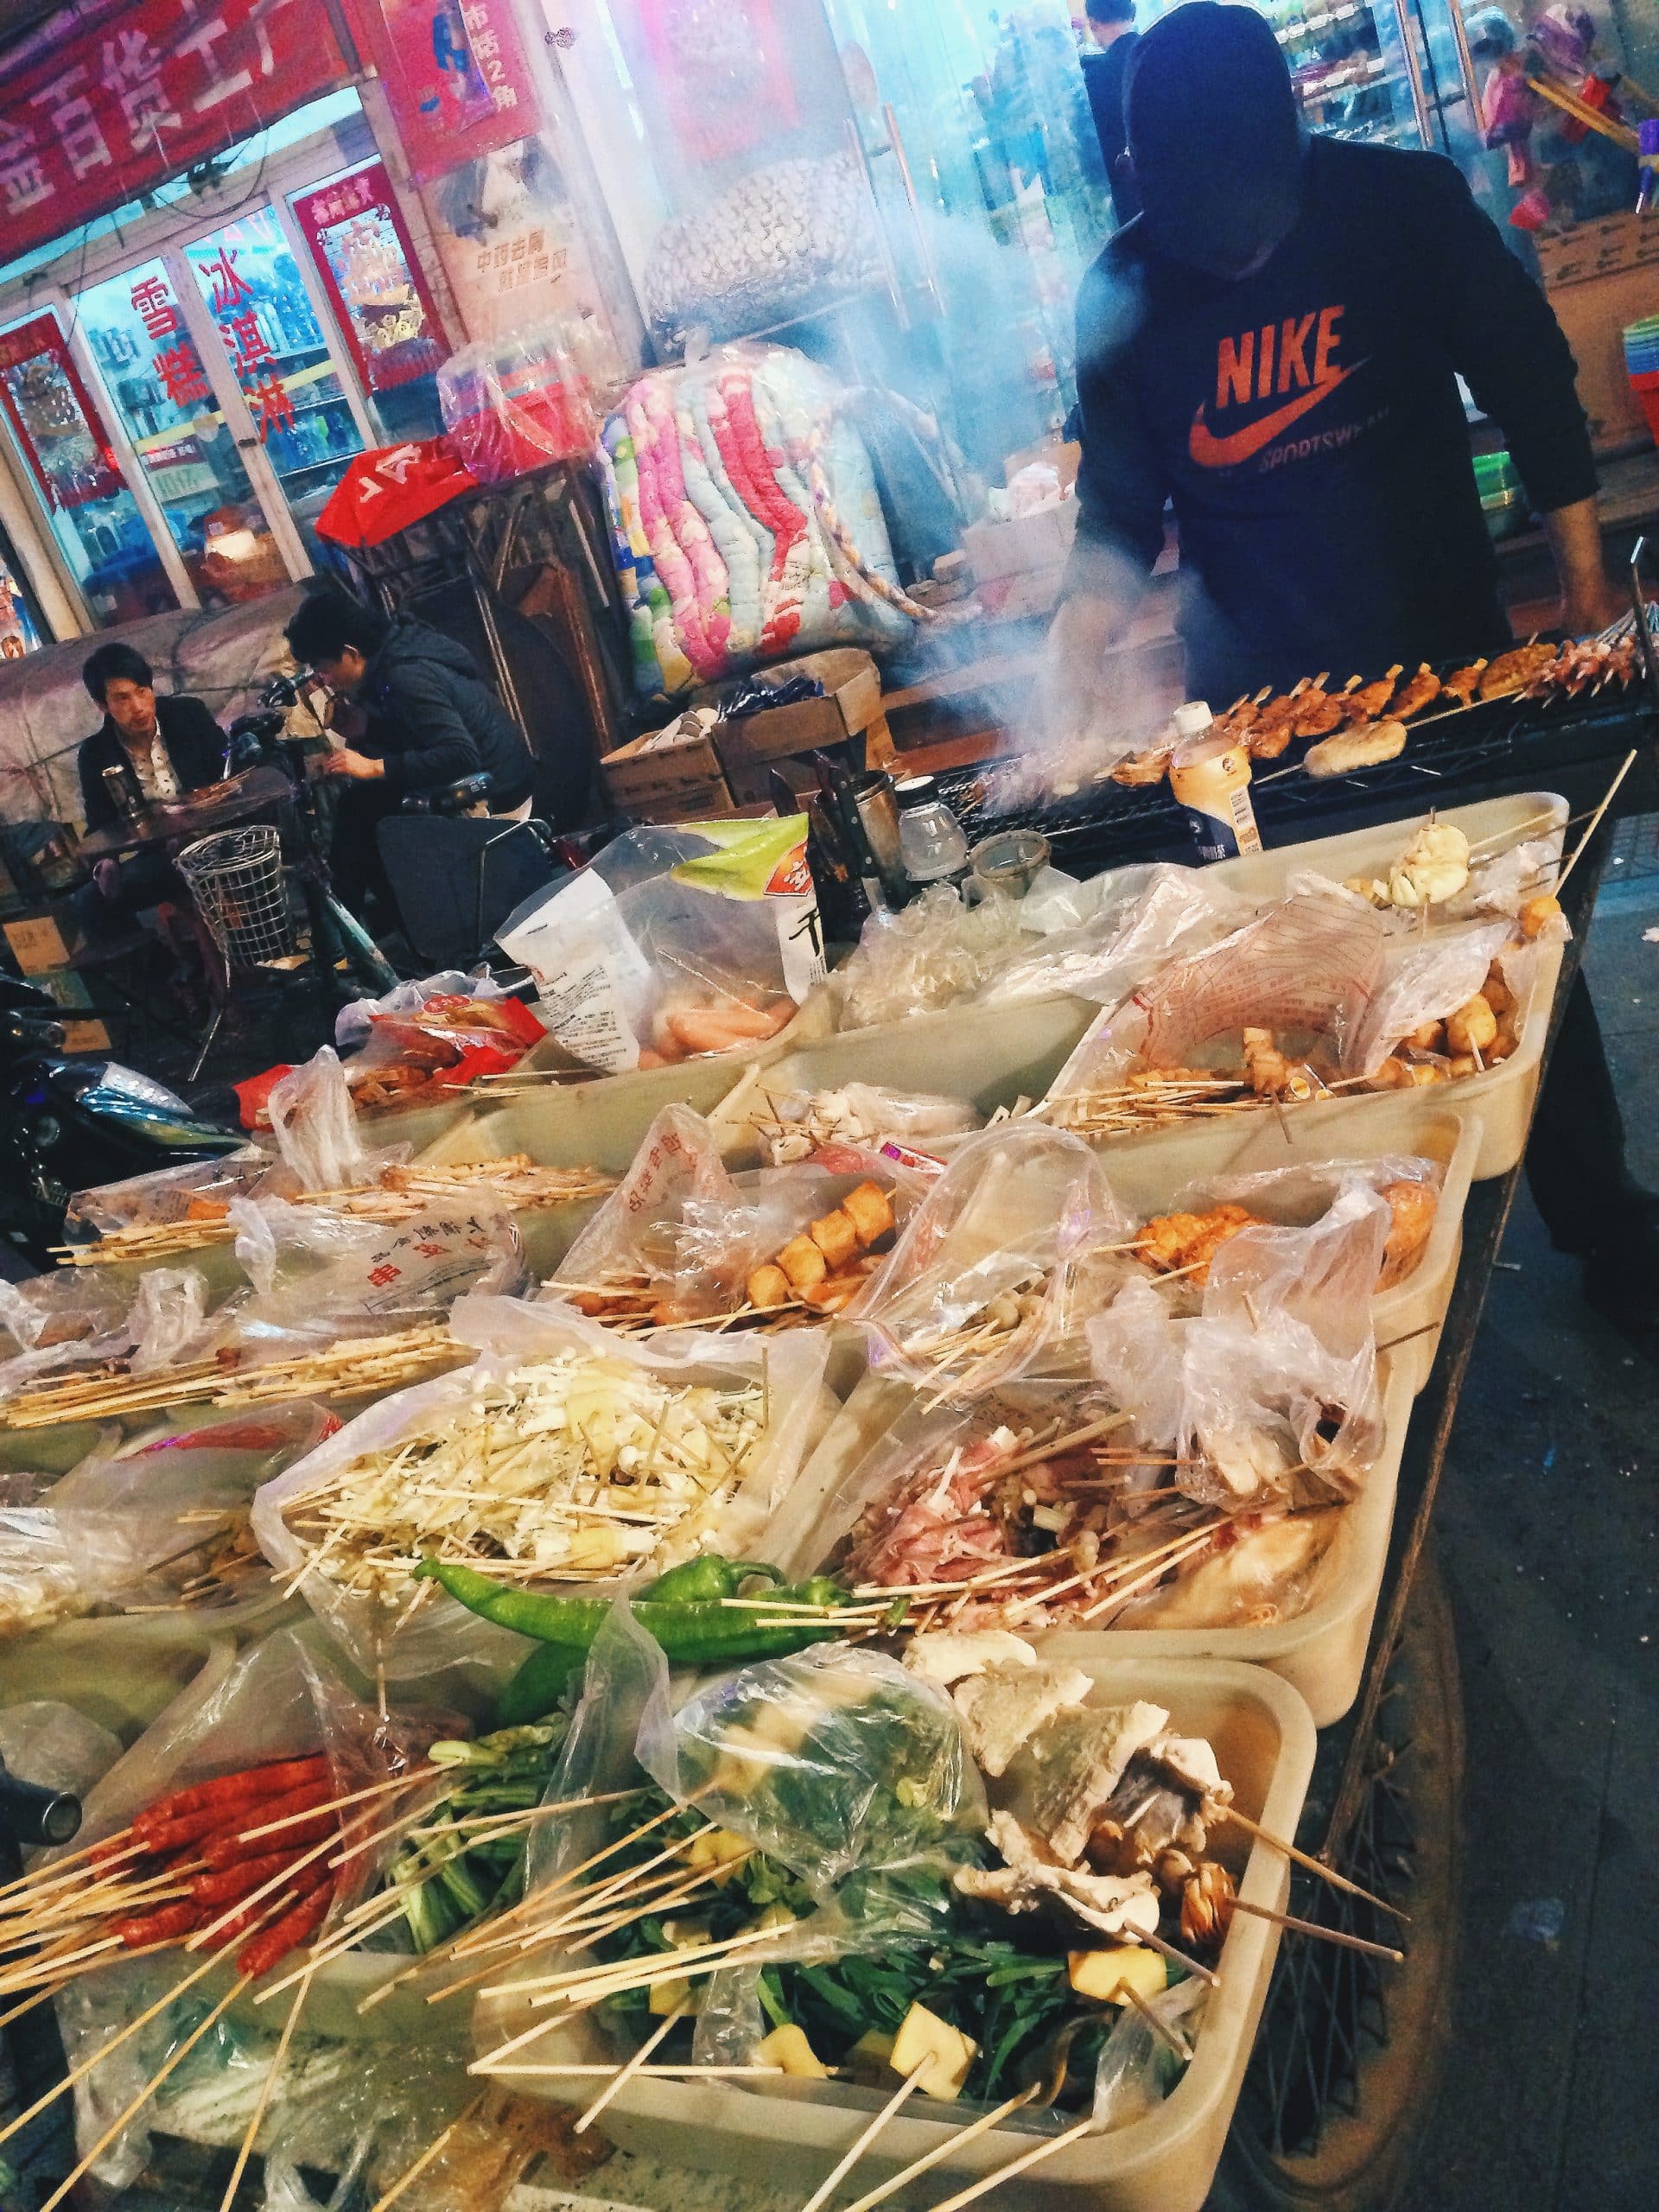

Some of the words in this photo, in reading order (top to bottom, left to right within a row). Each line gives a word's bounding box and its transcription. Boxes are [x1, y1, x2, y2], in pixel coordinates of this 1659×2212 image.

[130, 275, 209, 409] 雪糕
[198, 246, 295, 443] 冰淇淋
[1216, 304, 1344, 410] NIKE
